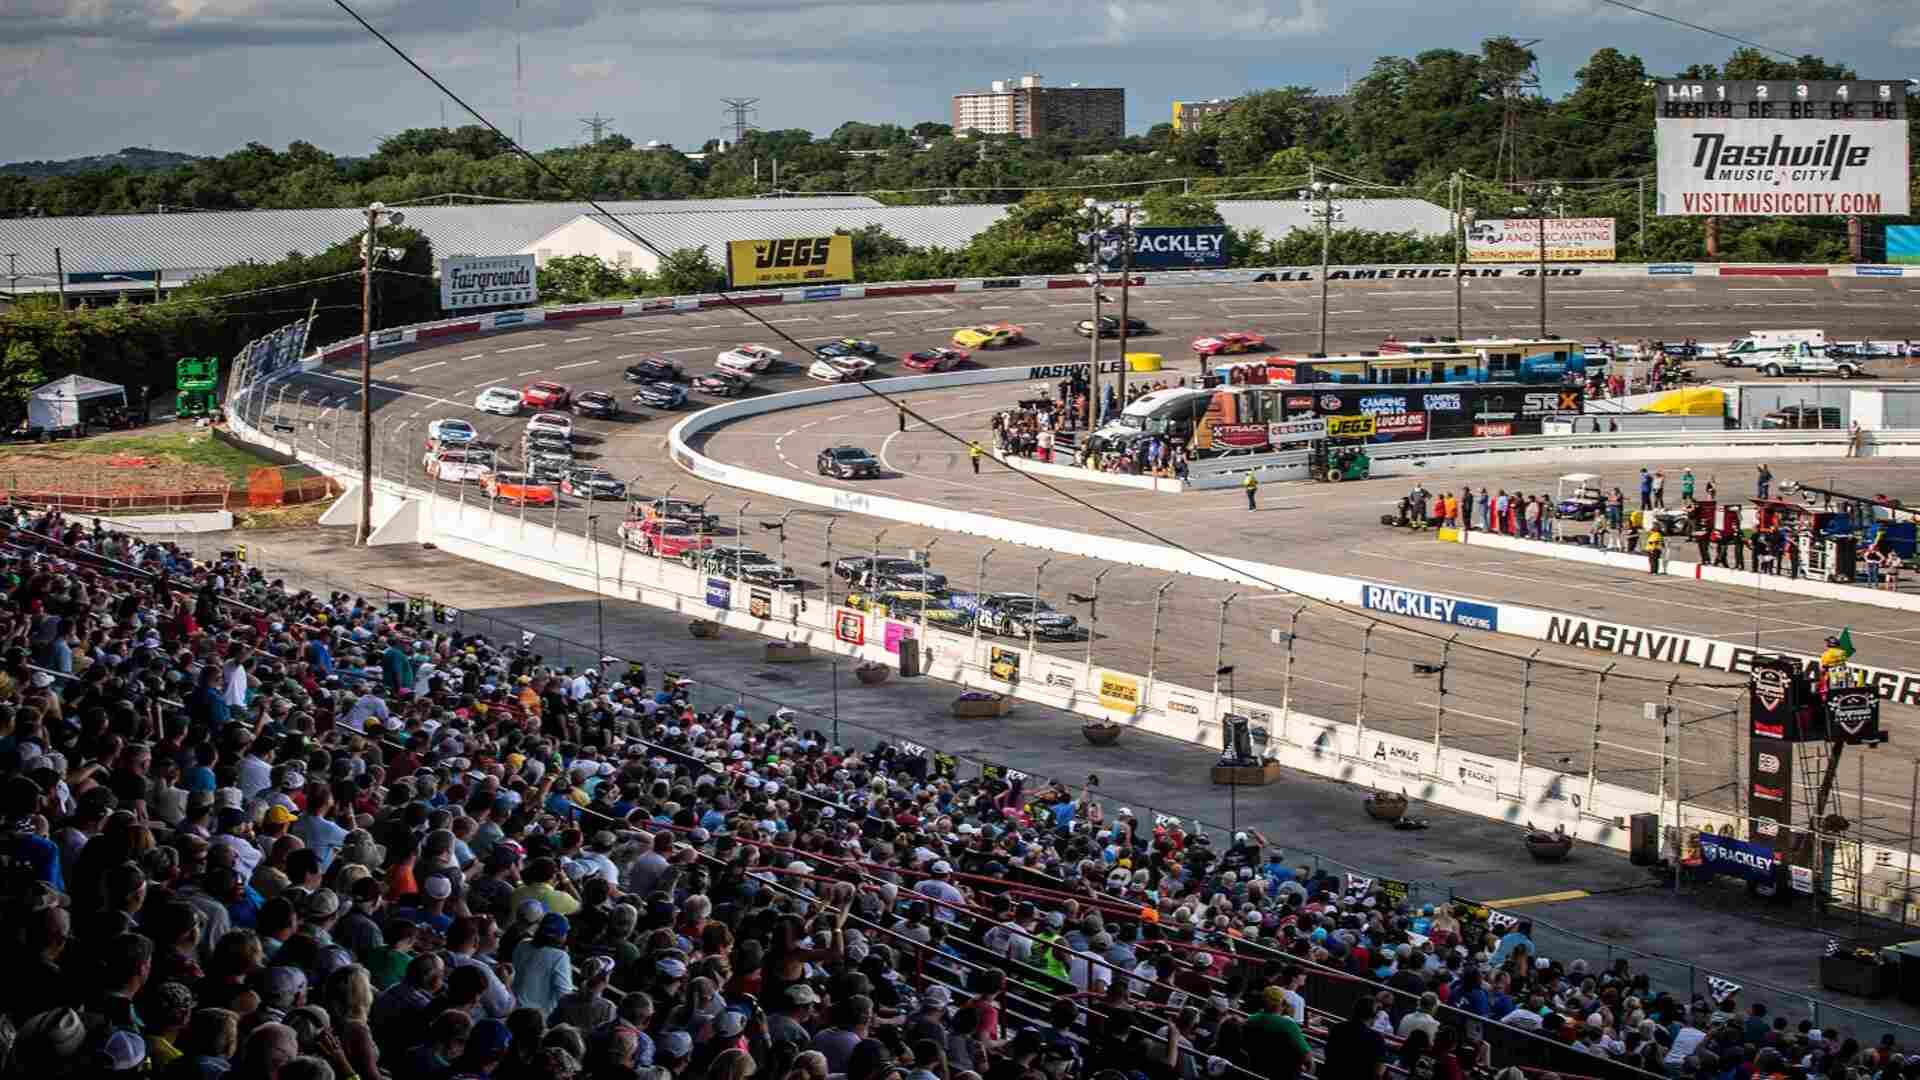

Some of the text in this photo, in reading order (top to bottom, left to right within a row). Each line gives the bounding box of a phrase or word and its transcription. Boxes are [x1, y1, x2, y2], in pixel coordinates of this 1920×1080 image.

[1668, 85, 1891, 98] LAP 1 2 3 4 5
[1692, 133, 1872, 181] Nashville
[1718, 169, 1828, 182] MUSIC CITY
[1682, 193, 1881, 214] VISITMUSICCITY.COM
[1550, 218, 1610, 229] TRUCKING
[1505, 231, 1611, 243] AND EXCAVATING
[755, 238, 832, 269] JEGS
[1253, 268, 1584, 283] ALL AMERICAN 400
[1423, 400, 1461, 411] WORLD
[1522, 392, 1579, 411] SRX
[1331, 417, 1375, 435] JEGS
[1376, 415, 1407, 427] LUCAS
[1368, 586, 1457, 625] RACKLEY
[1547, 616, 1753, 673] NASHVILLE
[1719, 847, 1773, 871] RACKLEY
